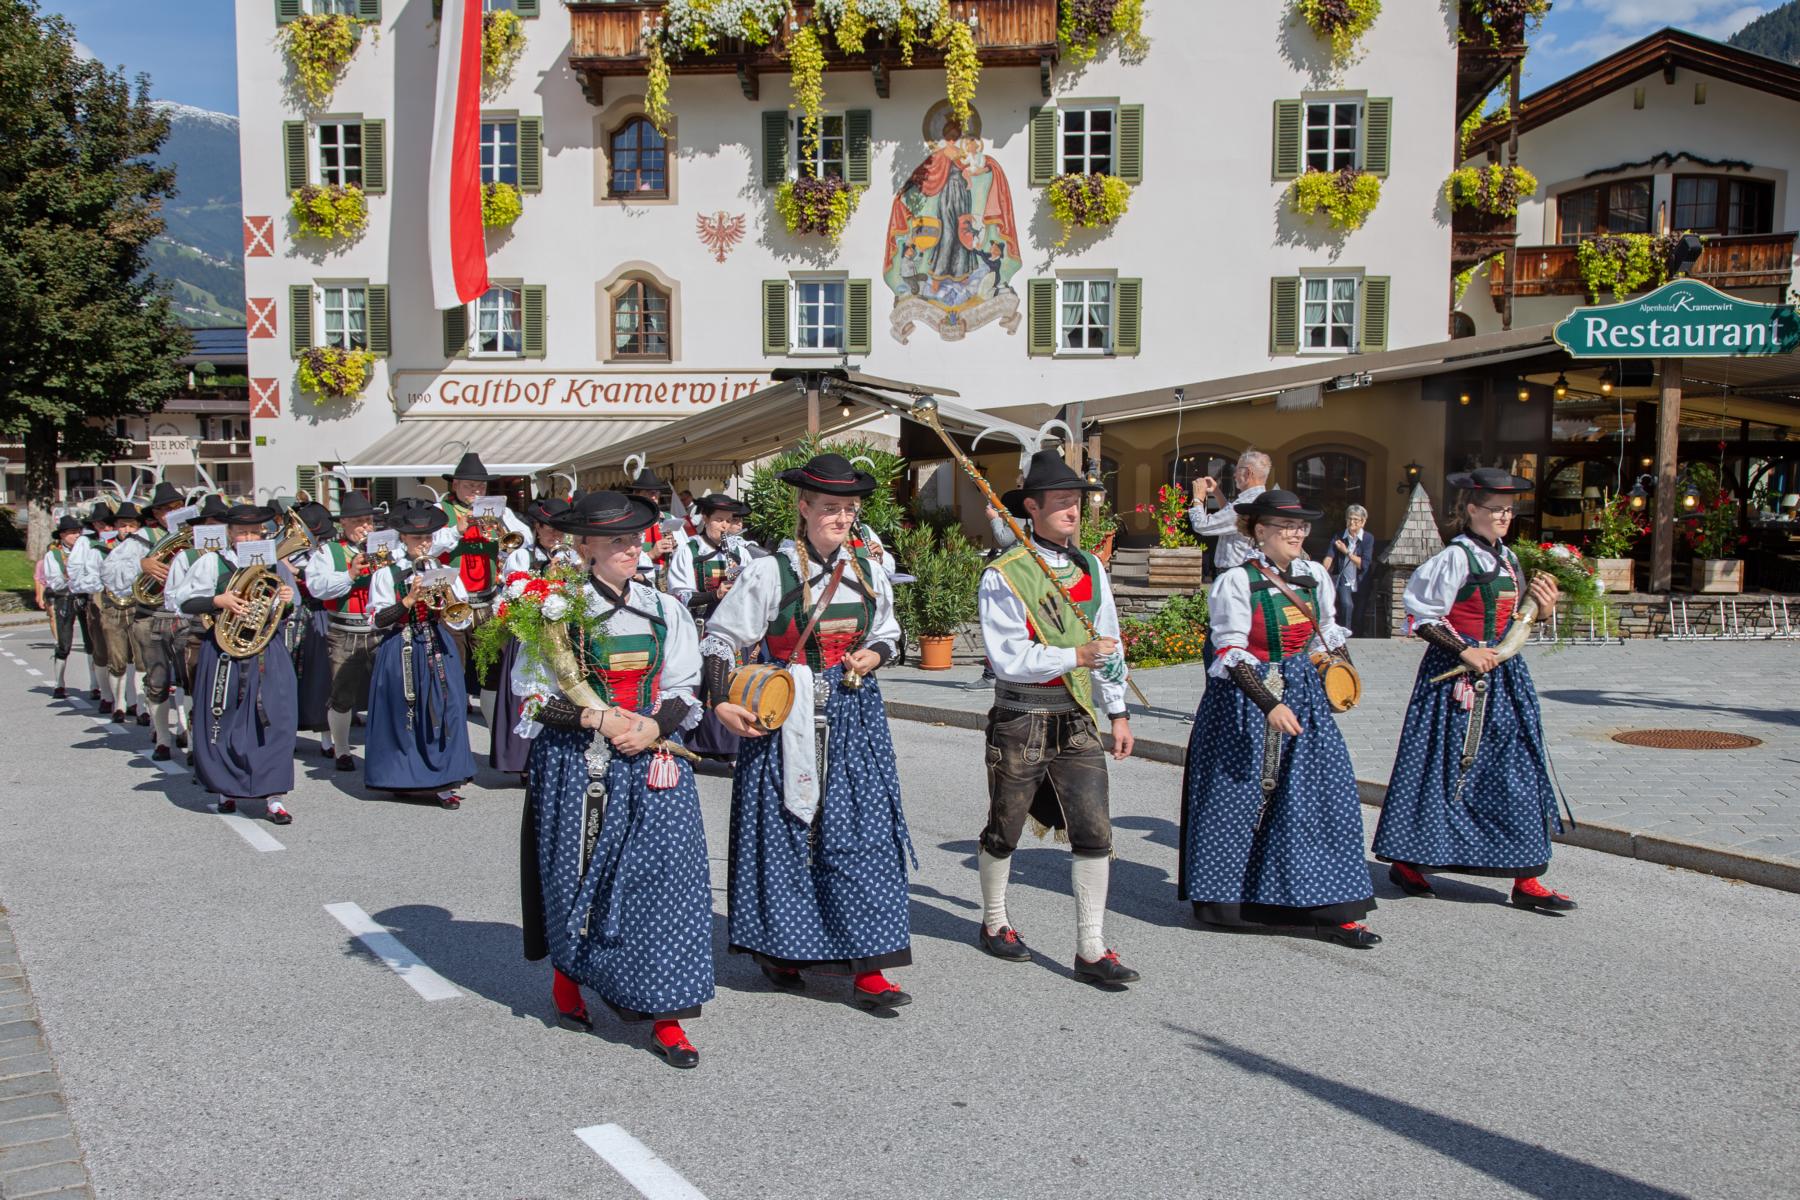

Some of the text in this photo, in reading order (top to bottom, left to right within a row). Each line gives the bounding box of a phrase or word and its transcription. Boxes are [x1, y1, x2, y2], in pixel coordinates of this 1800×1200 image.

[1639, 296, 1733, 313] Alpenhotel Kramerwirt
[1584, 316, 1784, 348] Restaurant
[561, 376, 761, 408] Kramerwirt
